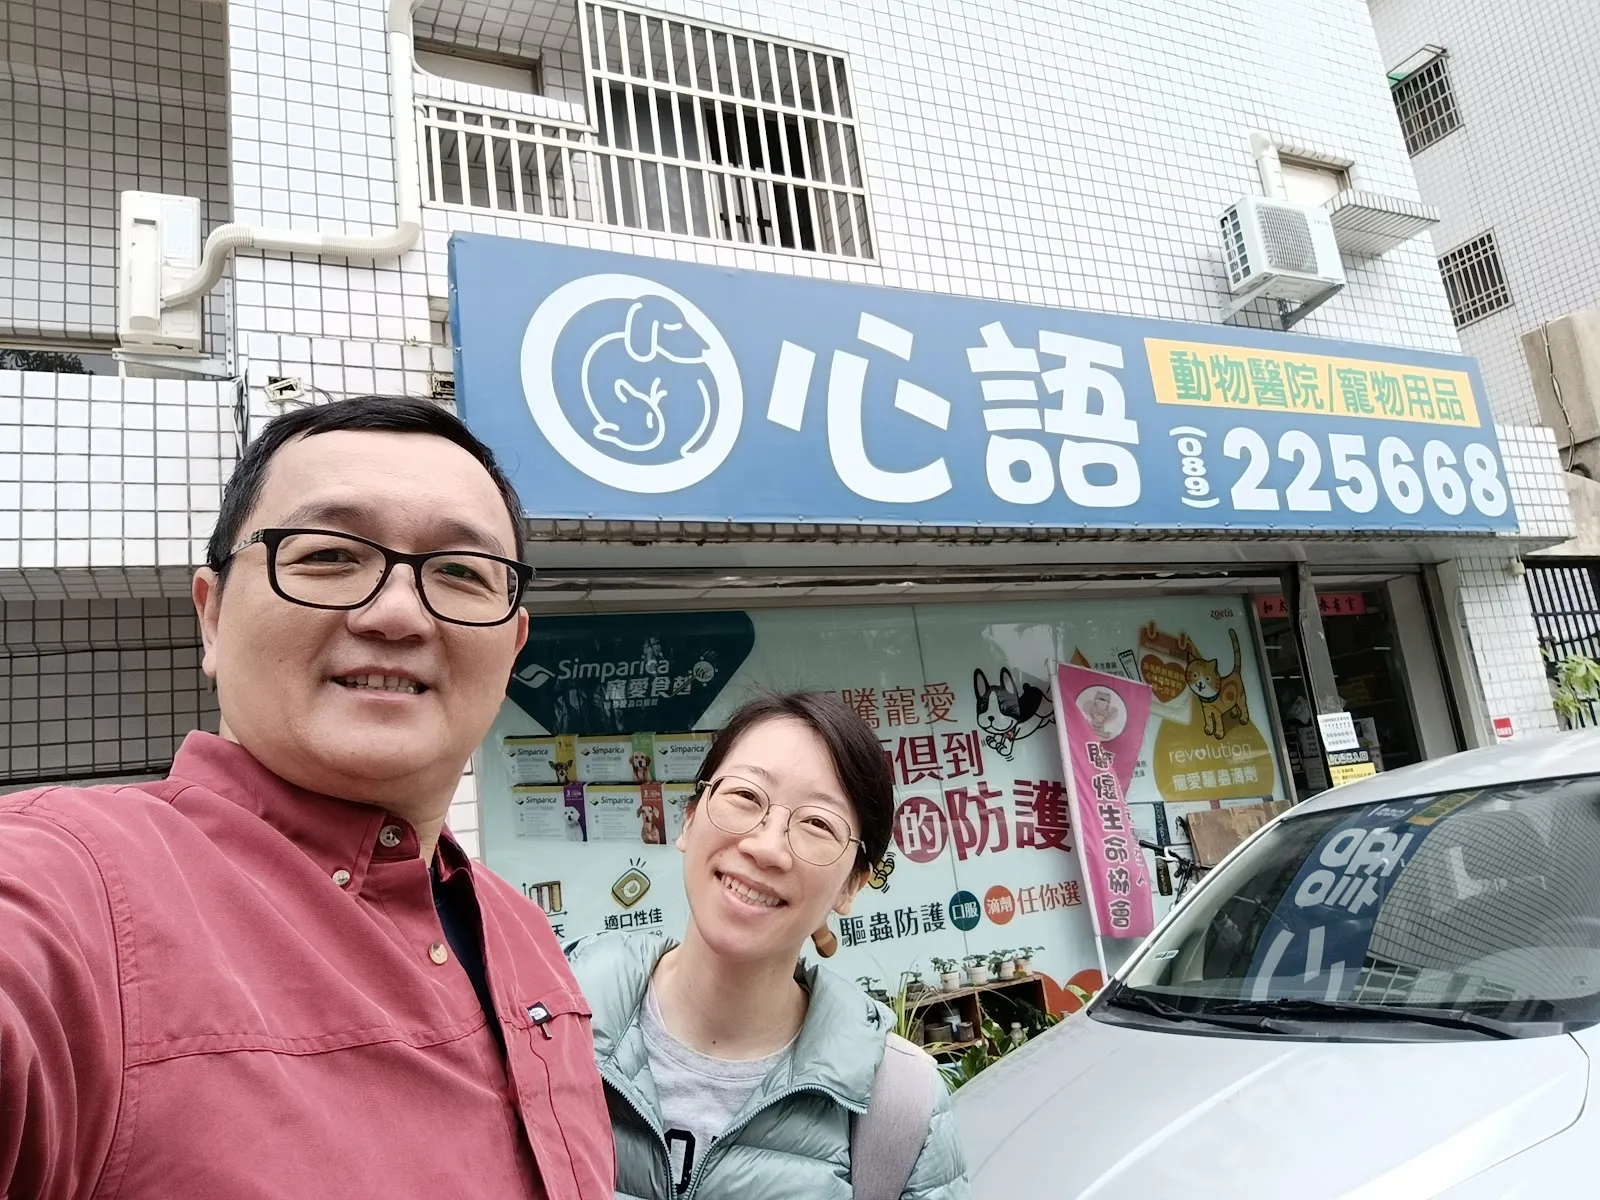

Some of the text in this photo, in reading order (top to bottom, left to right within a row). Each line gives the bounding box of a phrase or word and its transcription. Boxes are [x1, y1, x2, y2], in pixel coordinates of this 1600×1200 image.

[1169, 350, 1467, 422] 動物醫院/寵物用品
[766, 311, 1141, 508] 心語
[1169, 426, 1508, 517] (089) 225668
[1210, 608, 1234, 620] zoetis
[558, 658, 670, 683] Simparica
[822, 682, 958, 729] 騰寵愛
[517, 748, 549, 757] Simparica
[592, 746, 625, 755] Simparica
[671, 745, 705, 754] Simparica
[1168, 743, 1251, 764] revolution
[526, 796, 557, 805] Simparica
[601, 796, 634, 806] Simparica
[899, 779, 1072, 861] 的防護
[604, 908, 663, 930] 適口性佳
[839, 880, 1082, 947] 驅蟲防護 口服 滴劑 任你選
